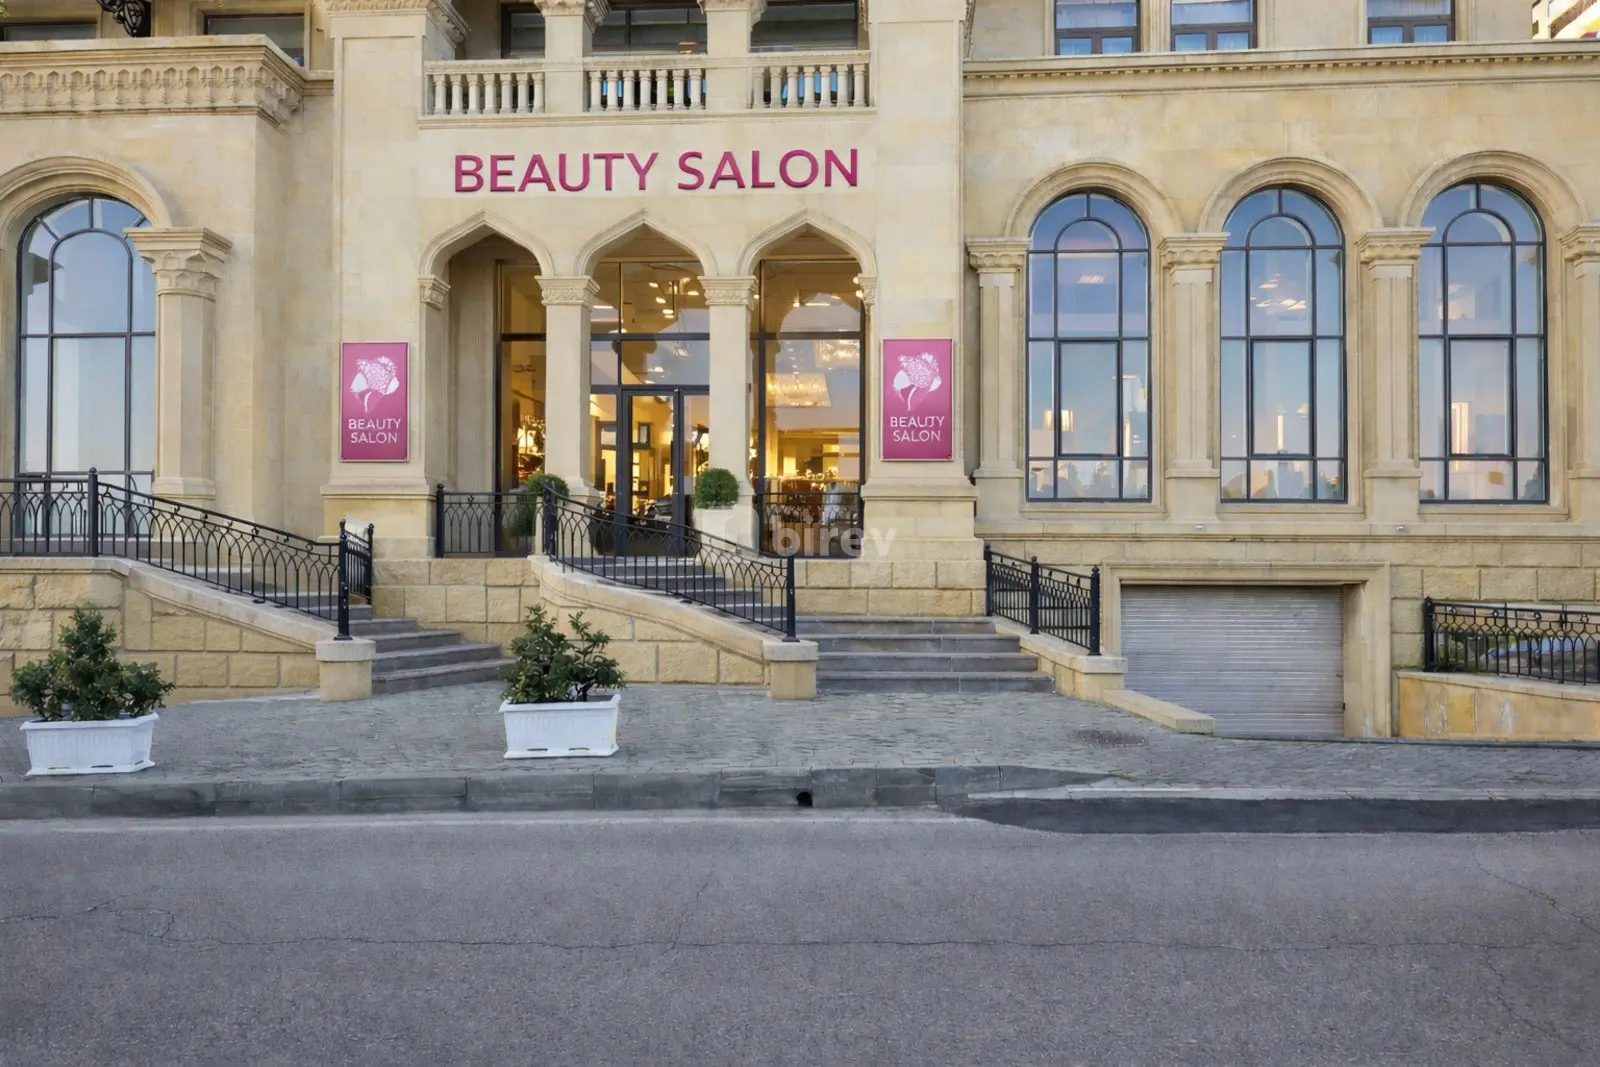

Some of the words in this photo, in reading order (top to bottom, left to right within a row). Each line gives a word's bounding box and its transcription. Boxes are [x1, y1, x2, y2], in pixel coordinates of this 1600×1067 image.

[454, 152, 659, 192] BEAUTY
[677, 148, 859, 190] SALON
[348, 418, 402, 430] BEAUTY
[890, 416, 945, 428] BEAUTY
[350, 431, 398, 444] SALON
[892, 429, 942, 442] SALON
